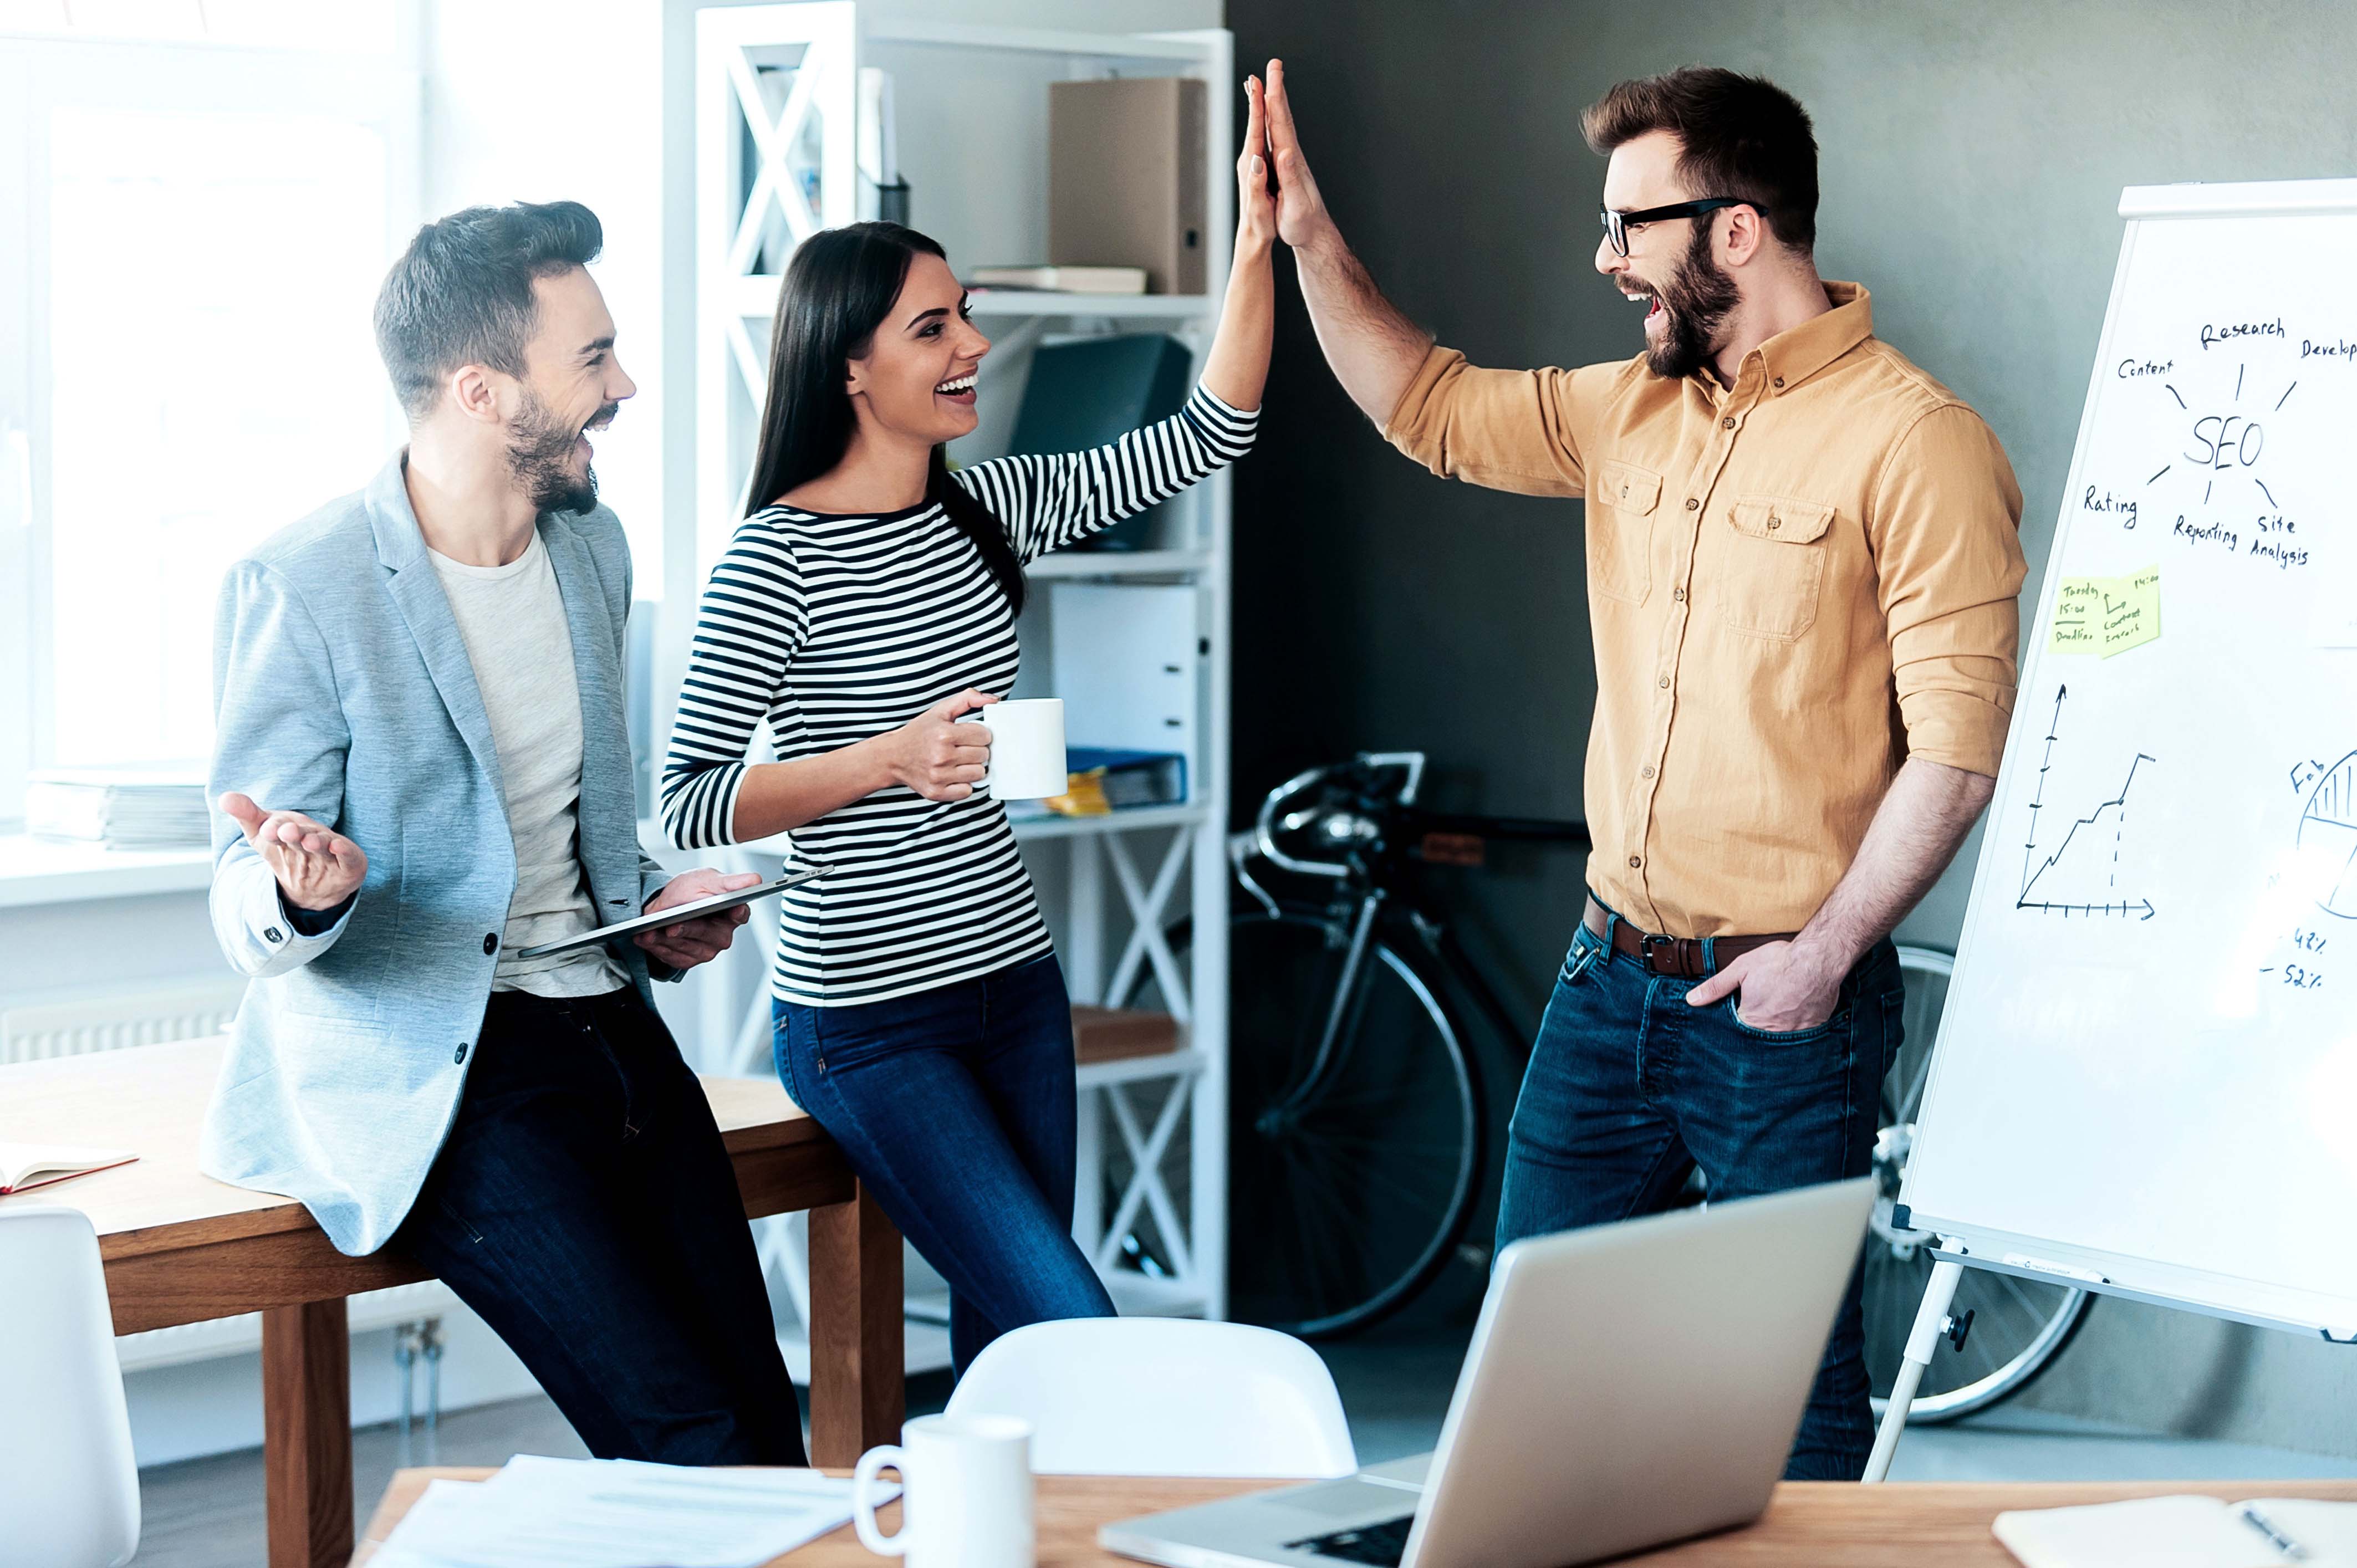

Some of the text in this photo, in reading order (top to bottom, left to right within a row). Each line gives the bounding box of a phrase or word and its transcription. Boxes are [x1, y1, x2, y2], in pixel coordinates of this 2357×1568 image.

[2201, 318, 2284, 350] Research
[2118, 359, 2174, 379] Content
[2183, 416, 2263, 471] SEO
[2084, 485, 2137, 530] Rating
[2174, 515, 2237, 551] Reporting
[2258, 515, 2295, 534] Site
[2250, 539, 2309, 570] Analysis
[2284, 964, 2322, 989] 52%
